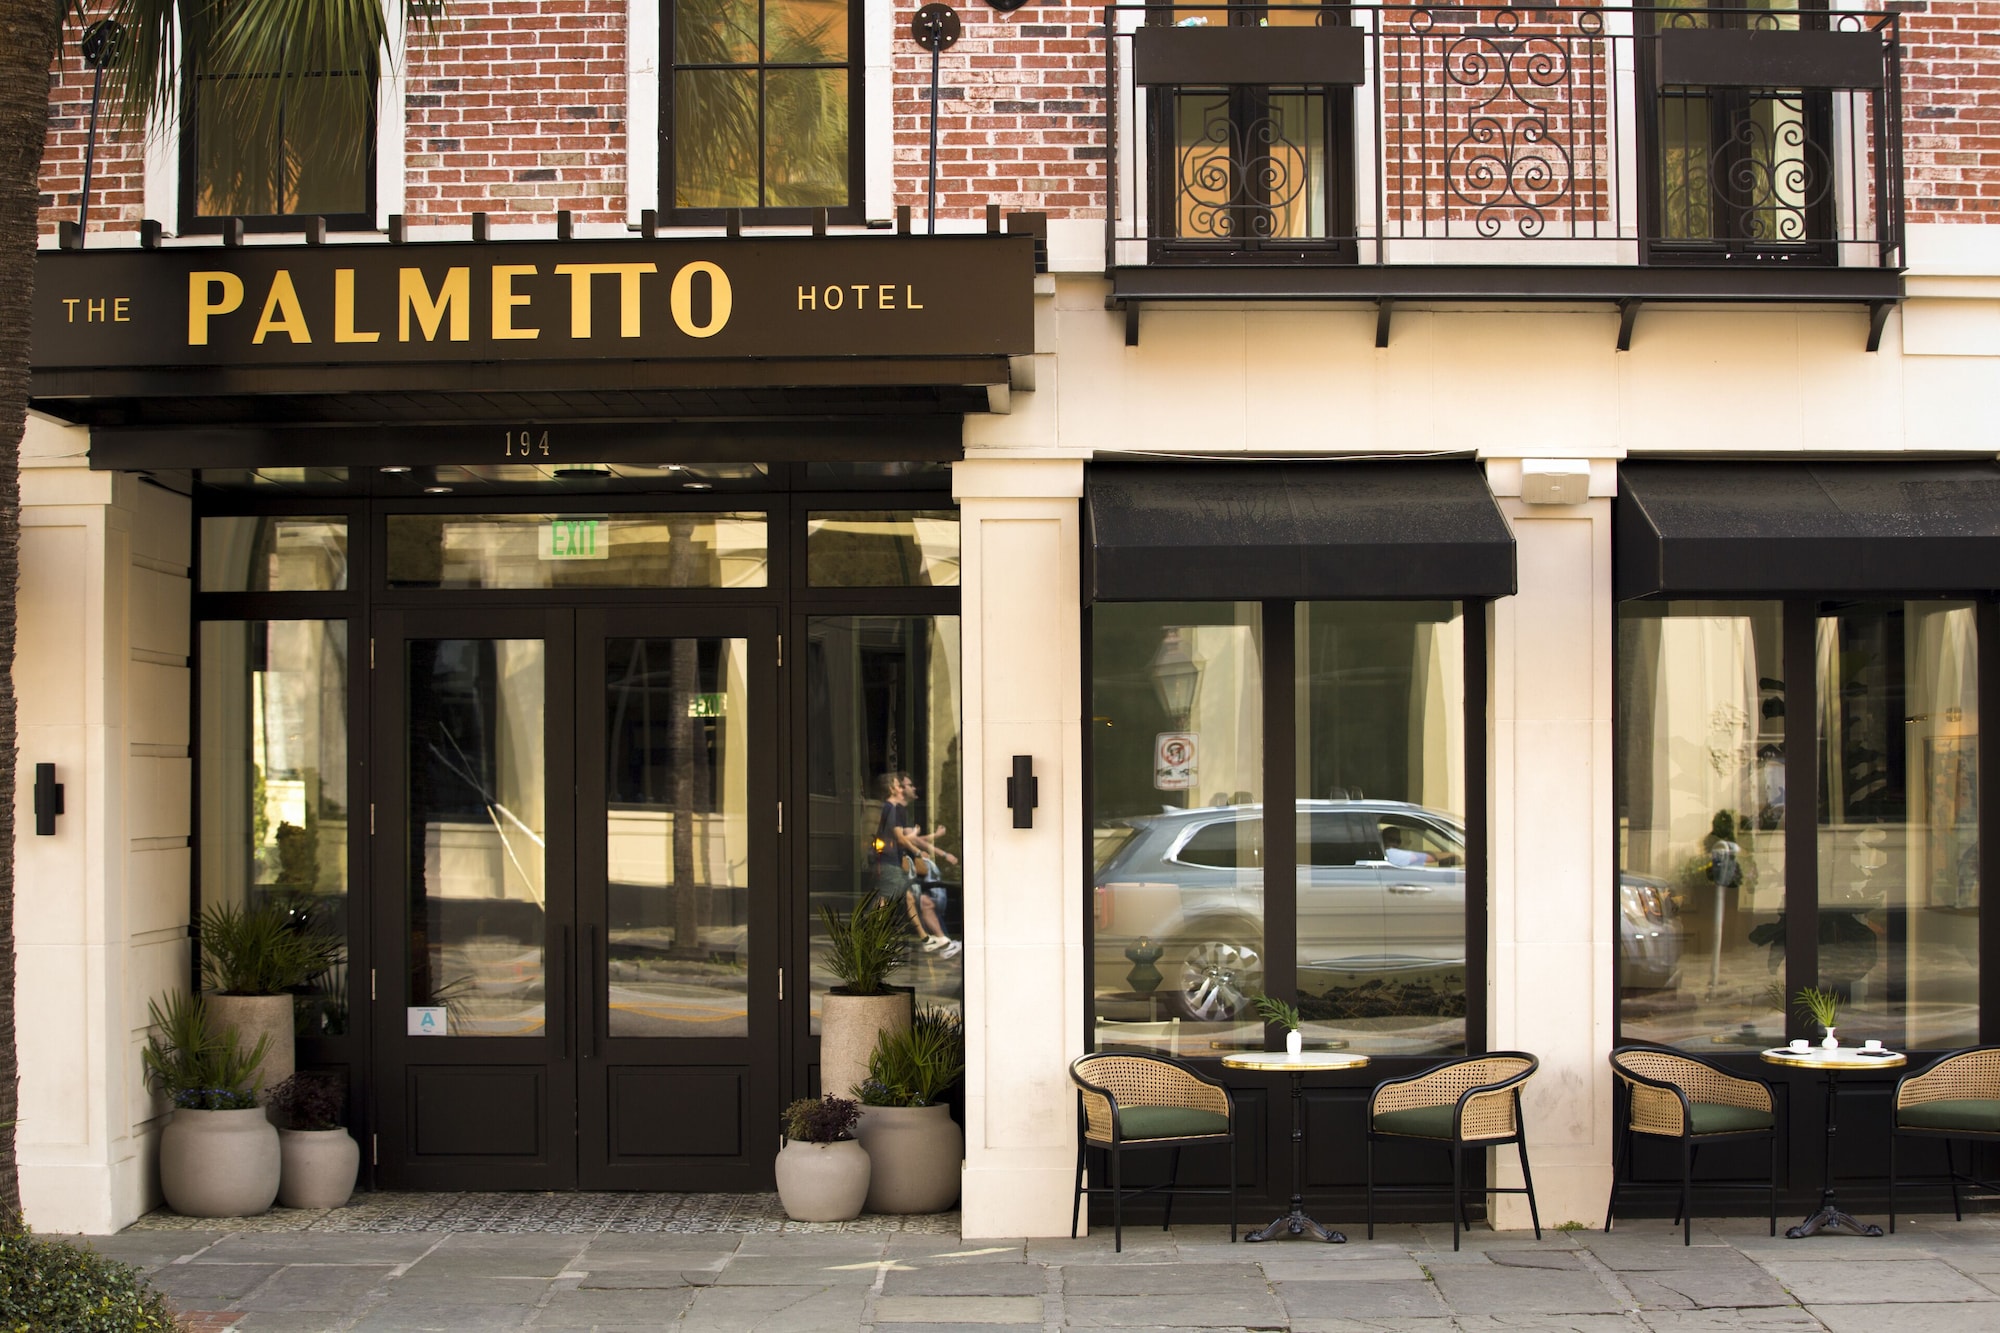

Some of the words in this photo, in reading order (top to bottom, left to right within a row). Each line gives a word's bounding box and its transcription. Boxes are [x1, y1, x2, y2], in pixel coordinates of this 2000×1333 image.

[62, 298, 131, 323] THE
[188, 260, 733, 346] PALMETTO
[798, 285, 925, 311] HOTEL
[505, 431, 549, 456] 194
[551, 520, 598, 556] EXIT
[420, 1011, 436, 1027] A
